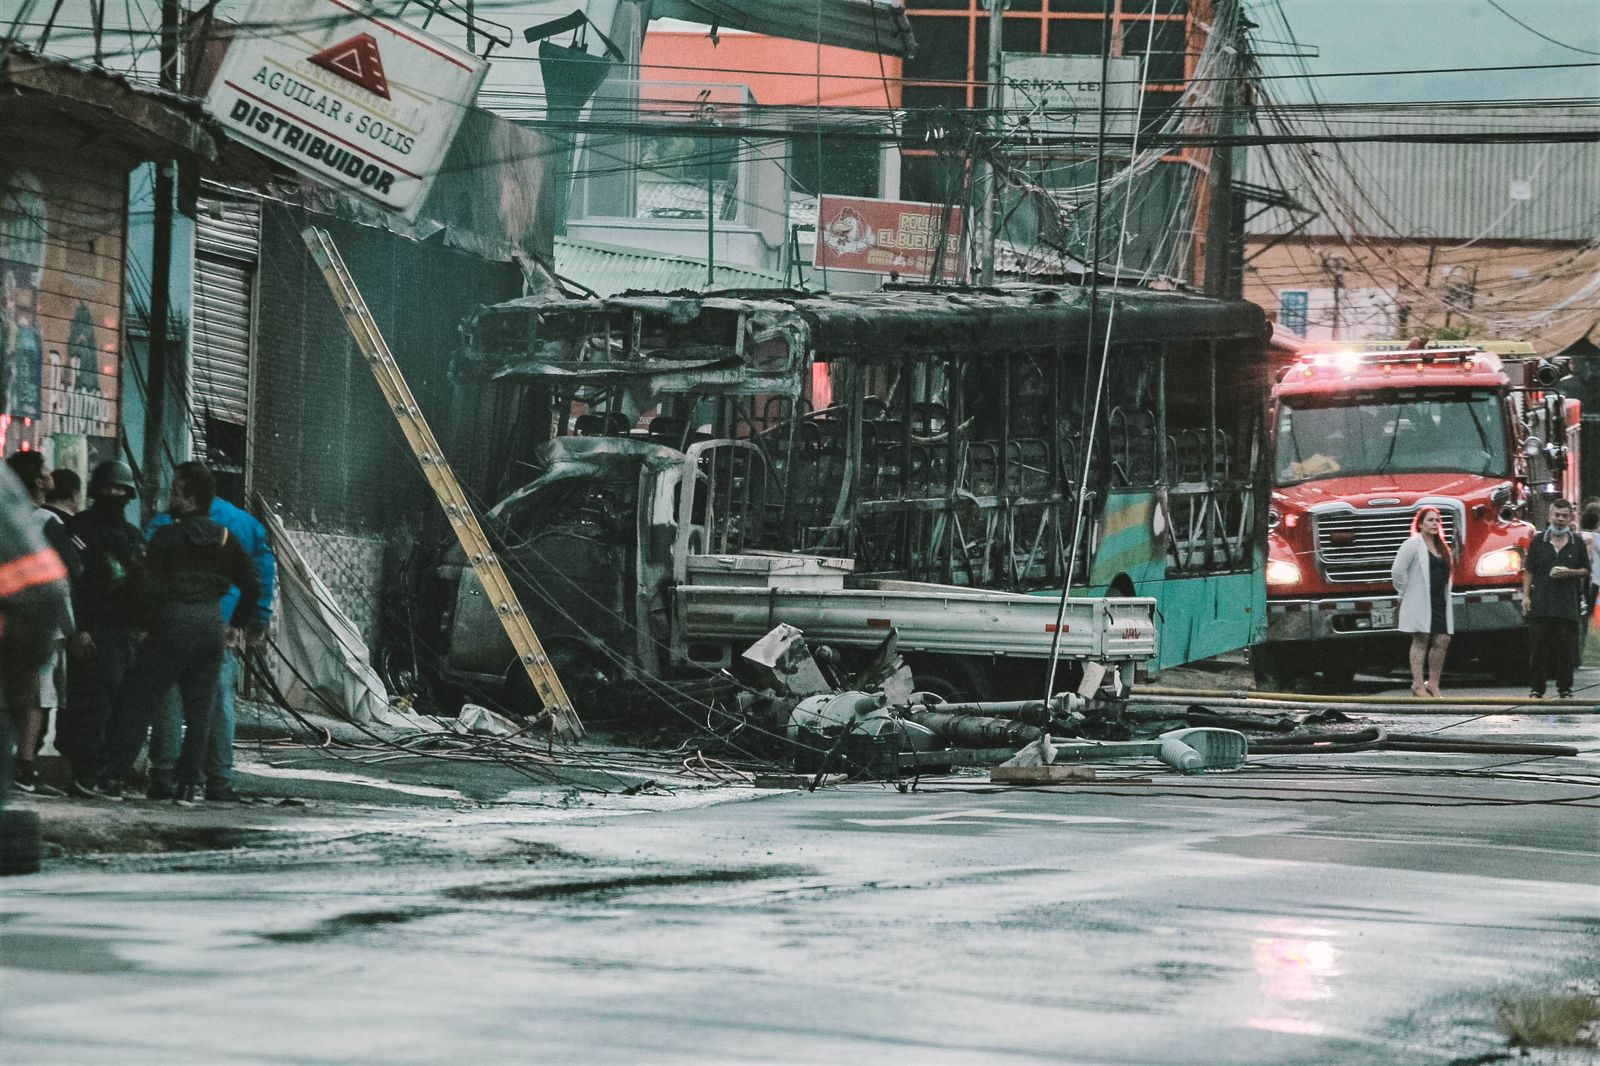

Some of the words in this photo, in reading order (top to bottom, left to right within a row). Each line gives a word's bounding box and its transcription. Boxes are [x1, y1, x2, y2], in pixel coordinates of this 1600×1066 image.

[229, 98, 395, 195] DISTRIBUIDOR
[253, 66, 342, 121] AGUILAR
[344, 112, 353, 123] &
[356, 115, 415, 155] SOLIS
[879, 229, 895, 247] EL
